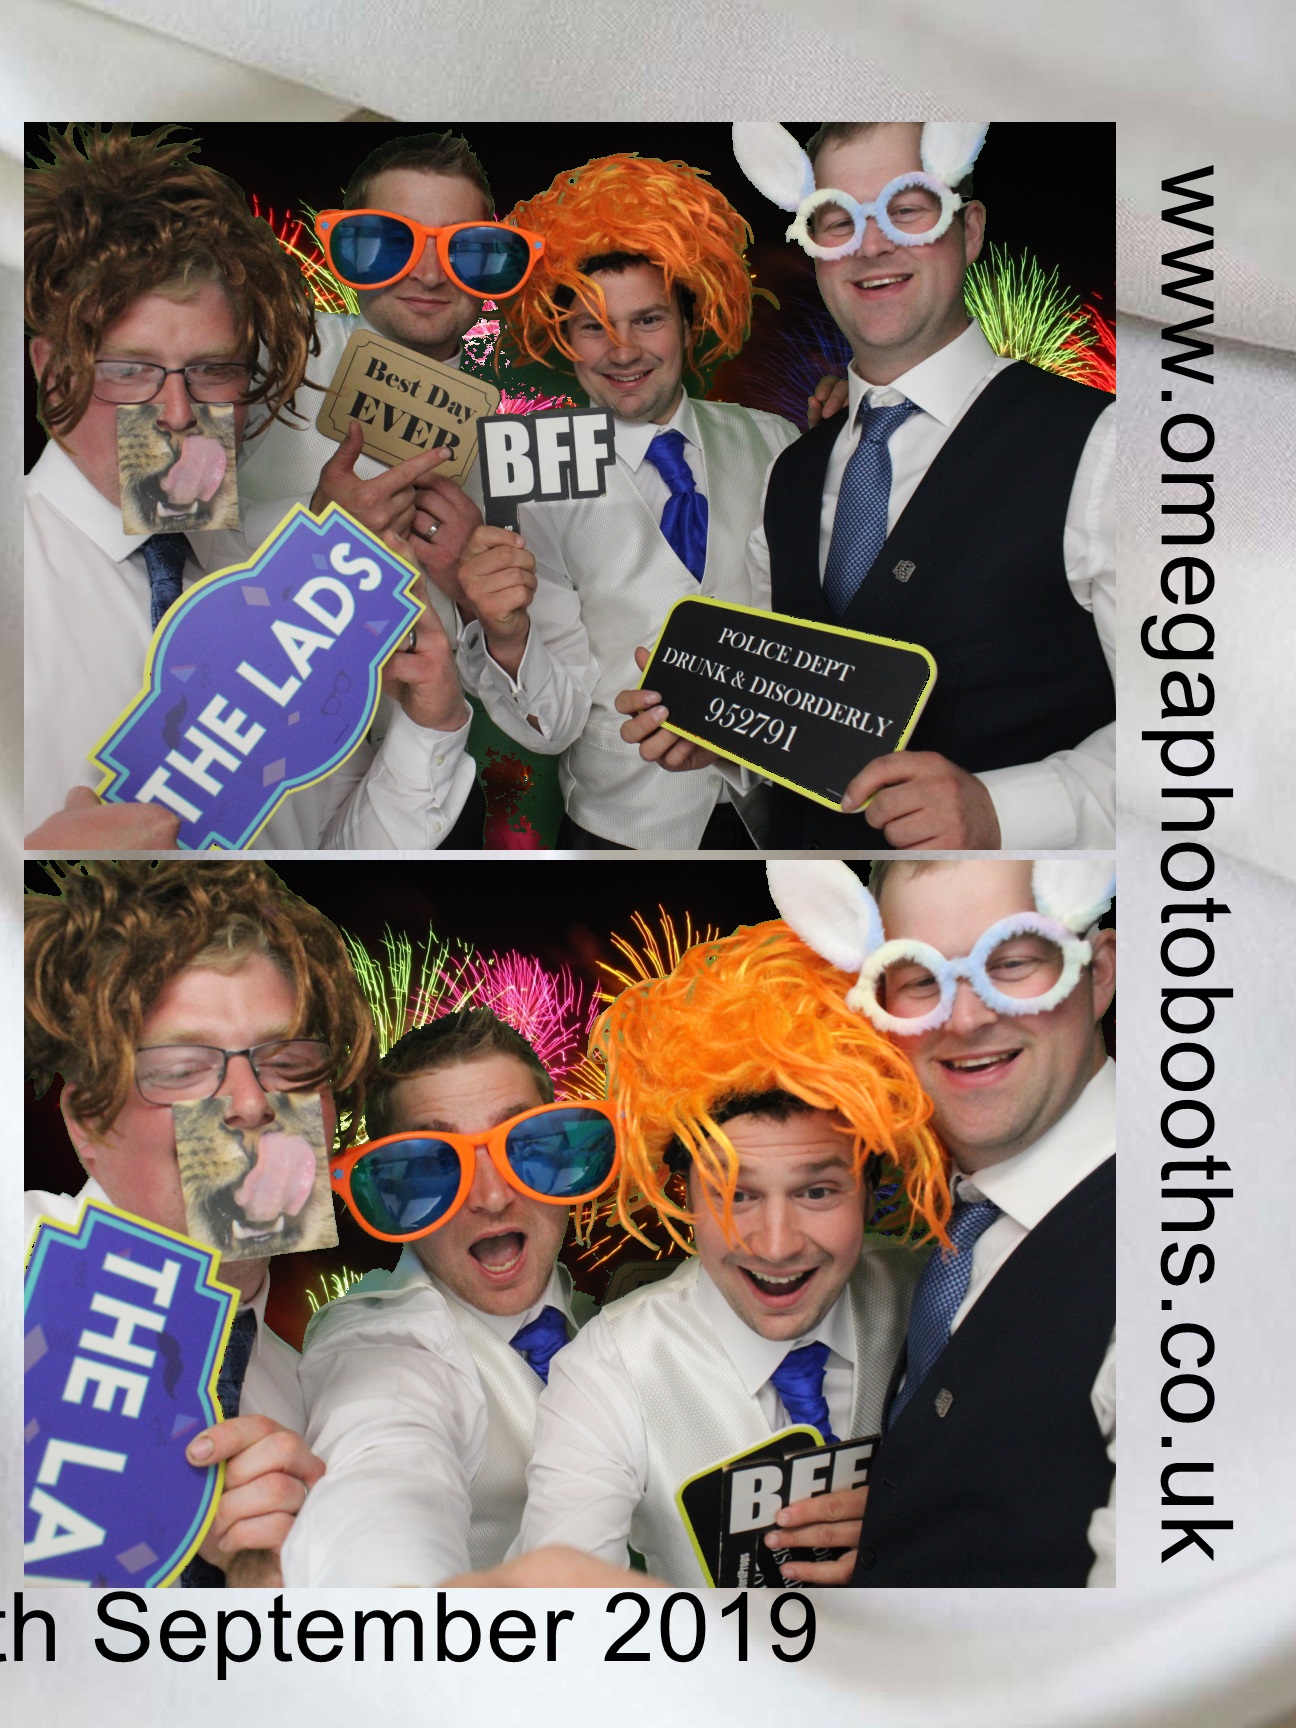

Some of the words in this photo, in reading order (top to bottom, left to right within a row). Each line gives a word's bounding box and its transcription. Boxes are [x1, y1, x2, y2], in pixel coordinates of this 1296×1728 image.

[346, 390, 461, 461] EVER
[363, 356, 422, 398] Best
[424, 383, 477, 424] Day
[484, 414, 608, 497] BFF
[135, 693, 267, 825] THE
[235, 542, 383, 707] LADS
[661, 646, 730, 685] DRUNK
[730, 669, 746, 690] &
[748, 675, 894, 738] DISORDERLY
[717, 627, 792, 664] POLICE
[792, 650, 855, 682] DEPT
[704, 697, 799, 752] 952791
[62, 1252, 182, 1419] THE
[24, 1438, 129, 1588] LA
